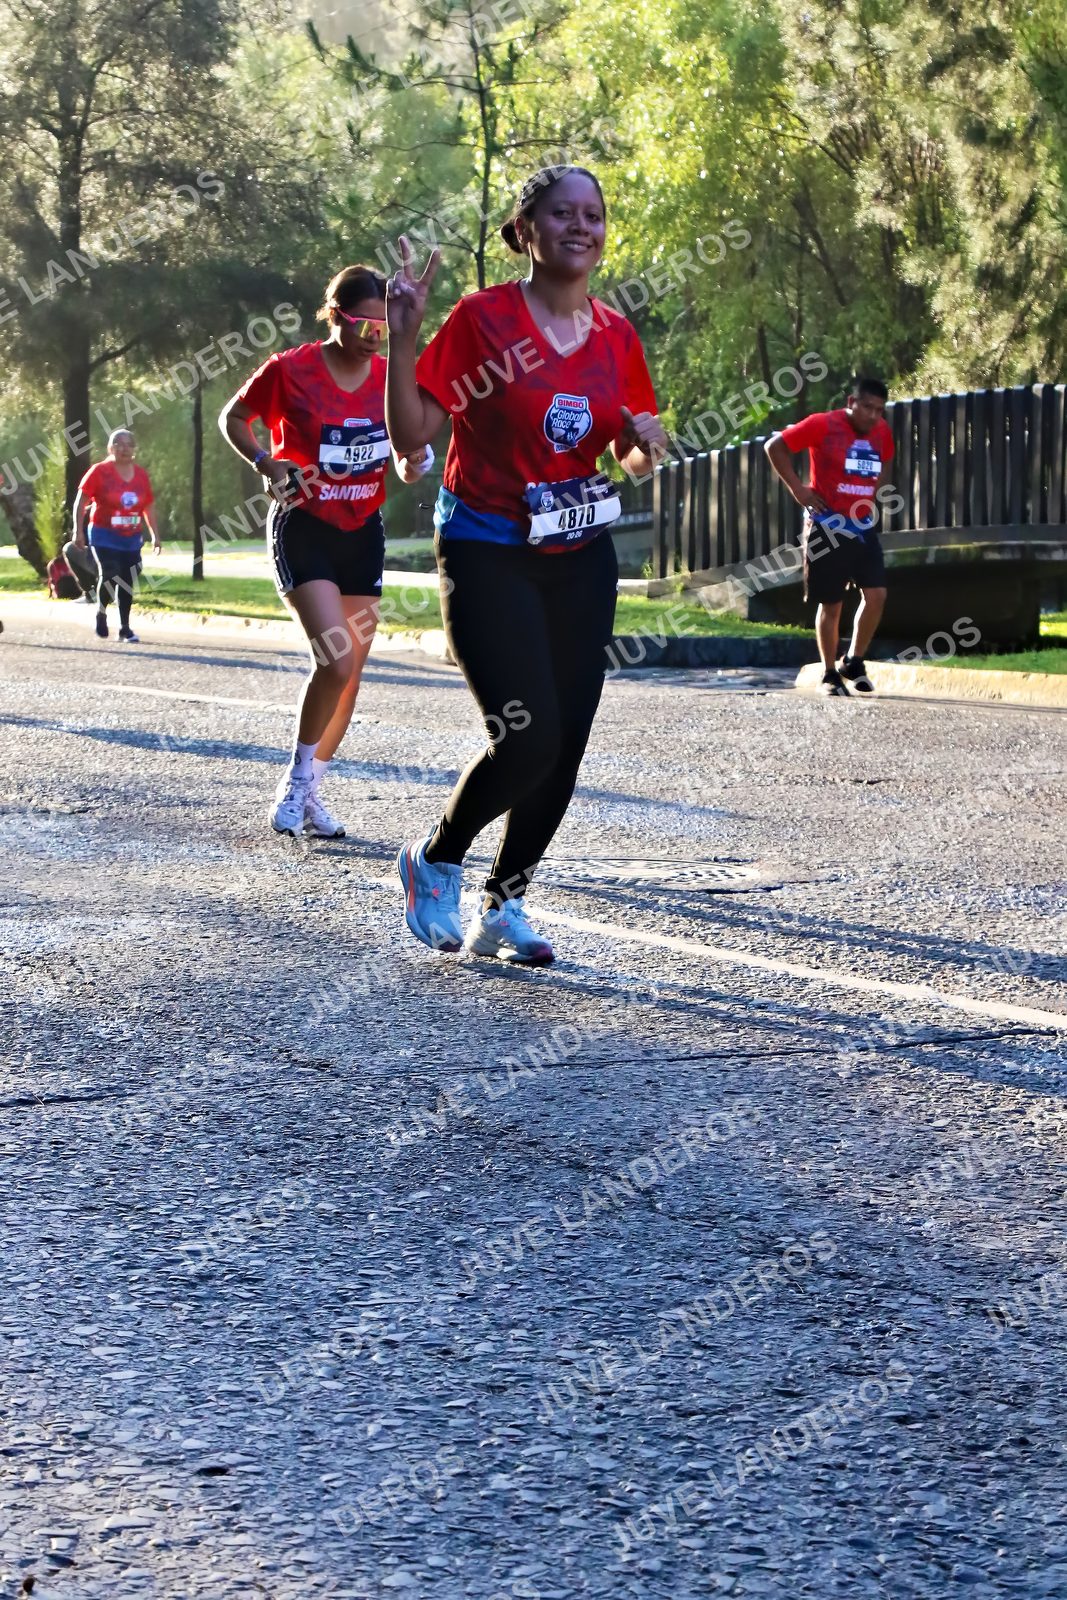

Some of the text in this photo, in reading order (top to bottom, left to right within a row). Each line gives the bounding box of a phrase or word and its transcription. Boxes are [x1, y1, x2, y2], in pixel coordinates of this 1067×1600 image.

[558, 399, 584, 409] BIMBO
[557, 410, 583, 421] Global
[552, 418, 571, 429] Race
[344, 444, 374, 463] 4922
[319, 482, 379, 501] SANTIAGO
[558, 504, 595, 531] 4870
